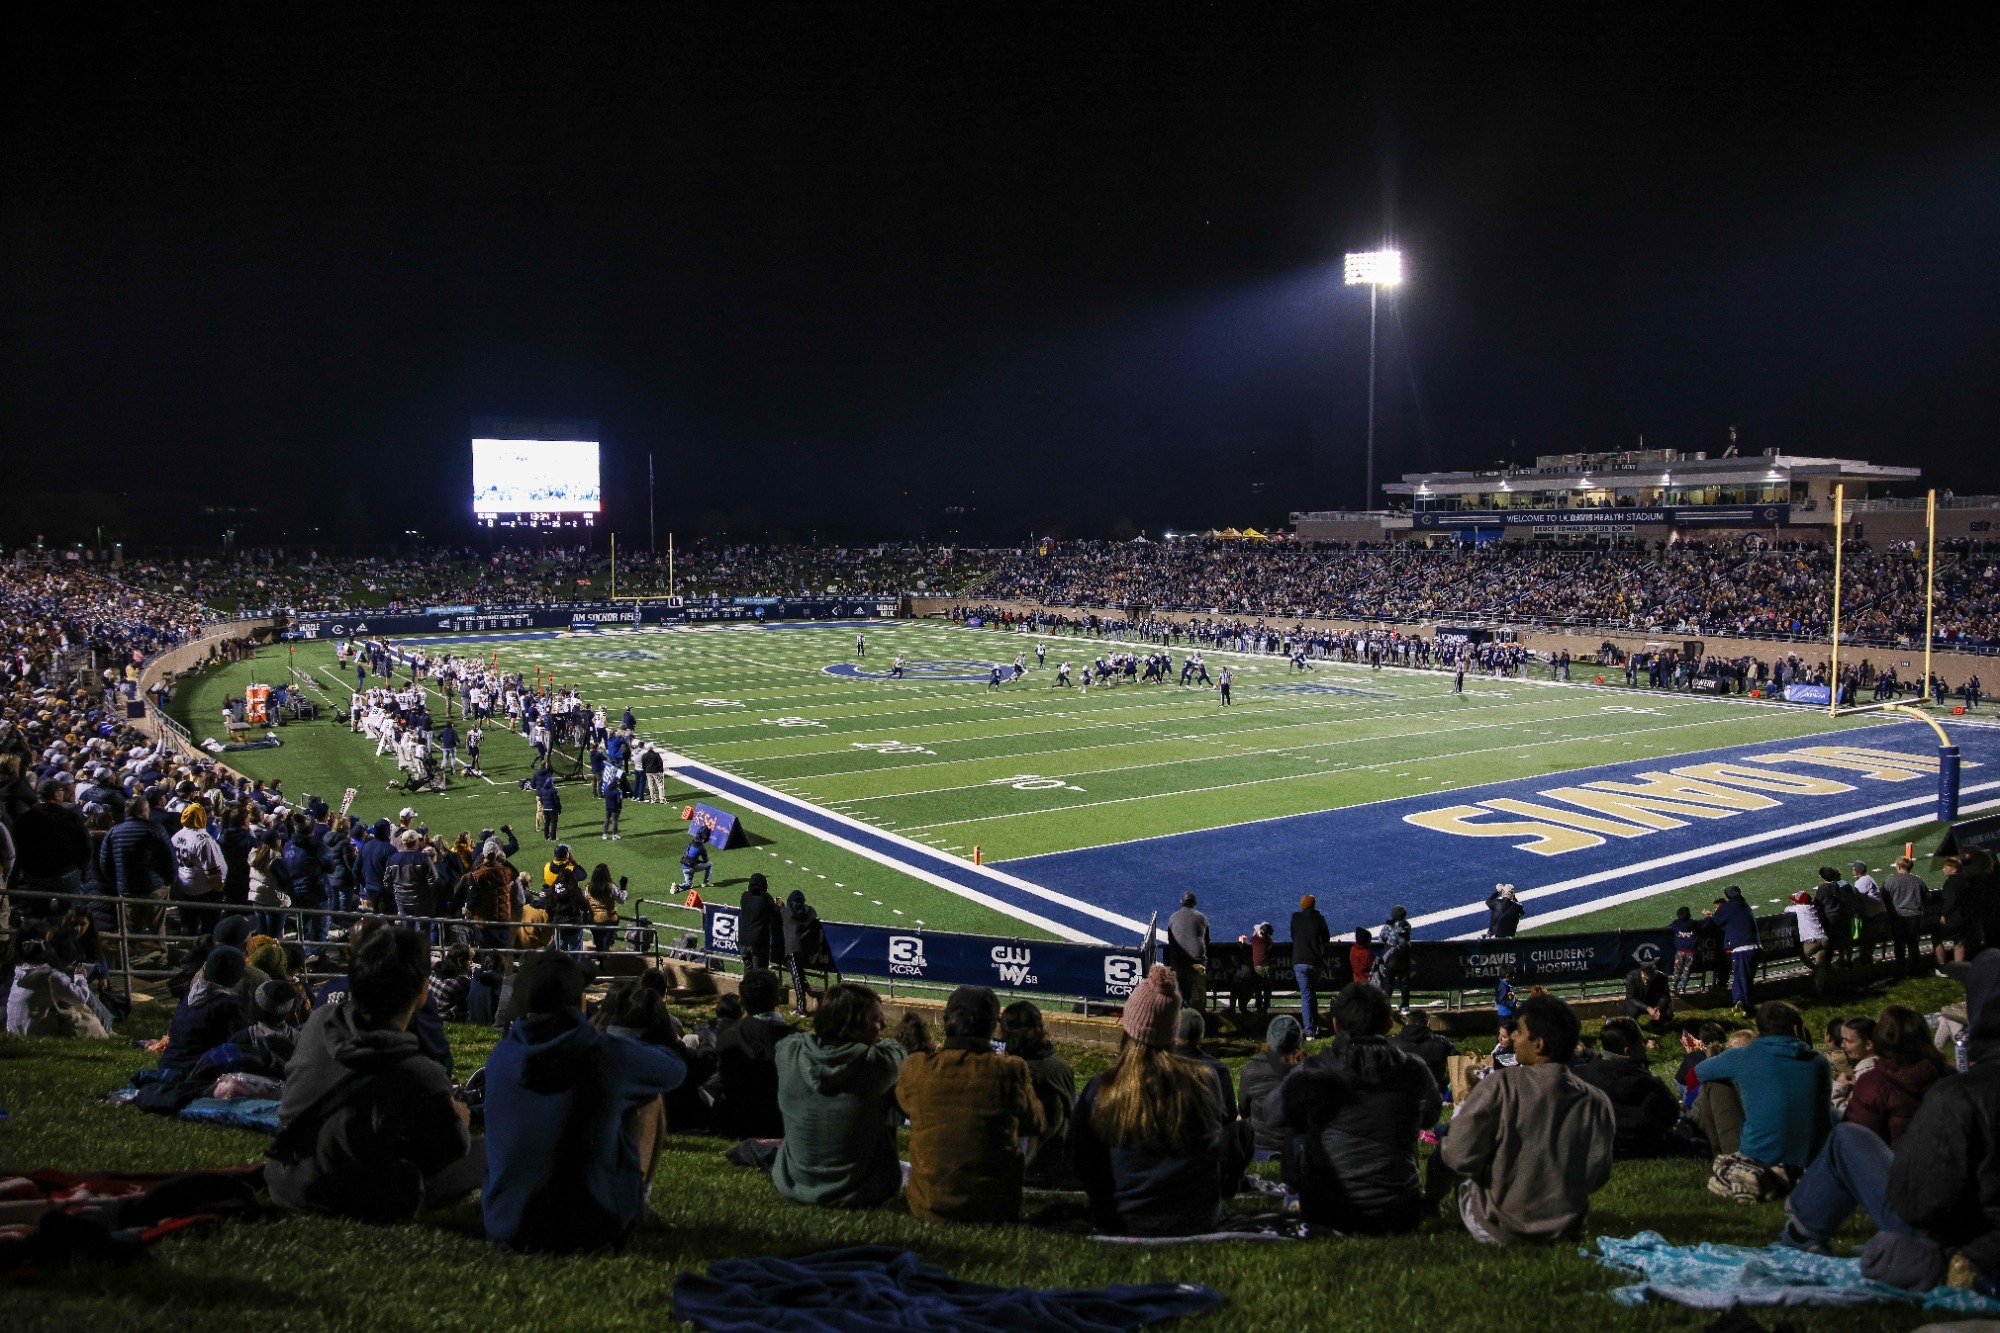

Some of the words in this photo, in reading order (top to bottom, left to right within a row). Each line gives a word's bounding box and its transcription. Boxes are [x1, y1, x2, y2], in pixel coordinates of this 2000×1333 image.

[1539, 466, 1569, 474] AGGIE
[1506, 514, 1544, 523] WELCOME
[1546, 515, 1557, 523] TO
[1626, 512, 1664, 521] STADIUM
[1402, 762, 1860, 856] DAVIS
[712, 938, 738, 951] KCRA
[1530, 947, 1596, 962] CHILDREN'S
[889, 964, 923, 976] KCRA
[1536, 960, 1589, 974] HOSPITAL
[999, 964, 1031, 985] MY
[1025, 975, 1038, 984] 58
[1105, 984, 1137, 996] KCR
